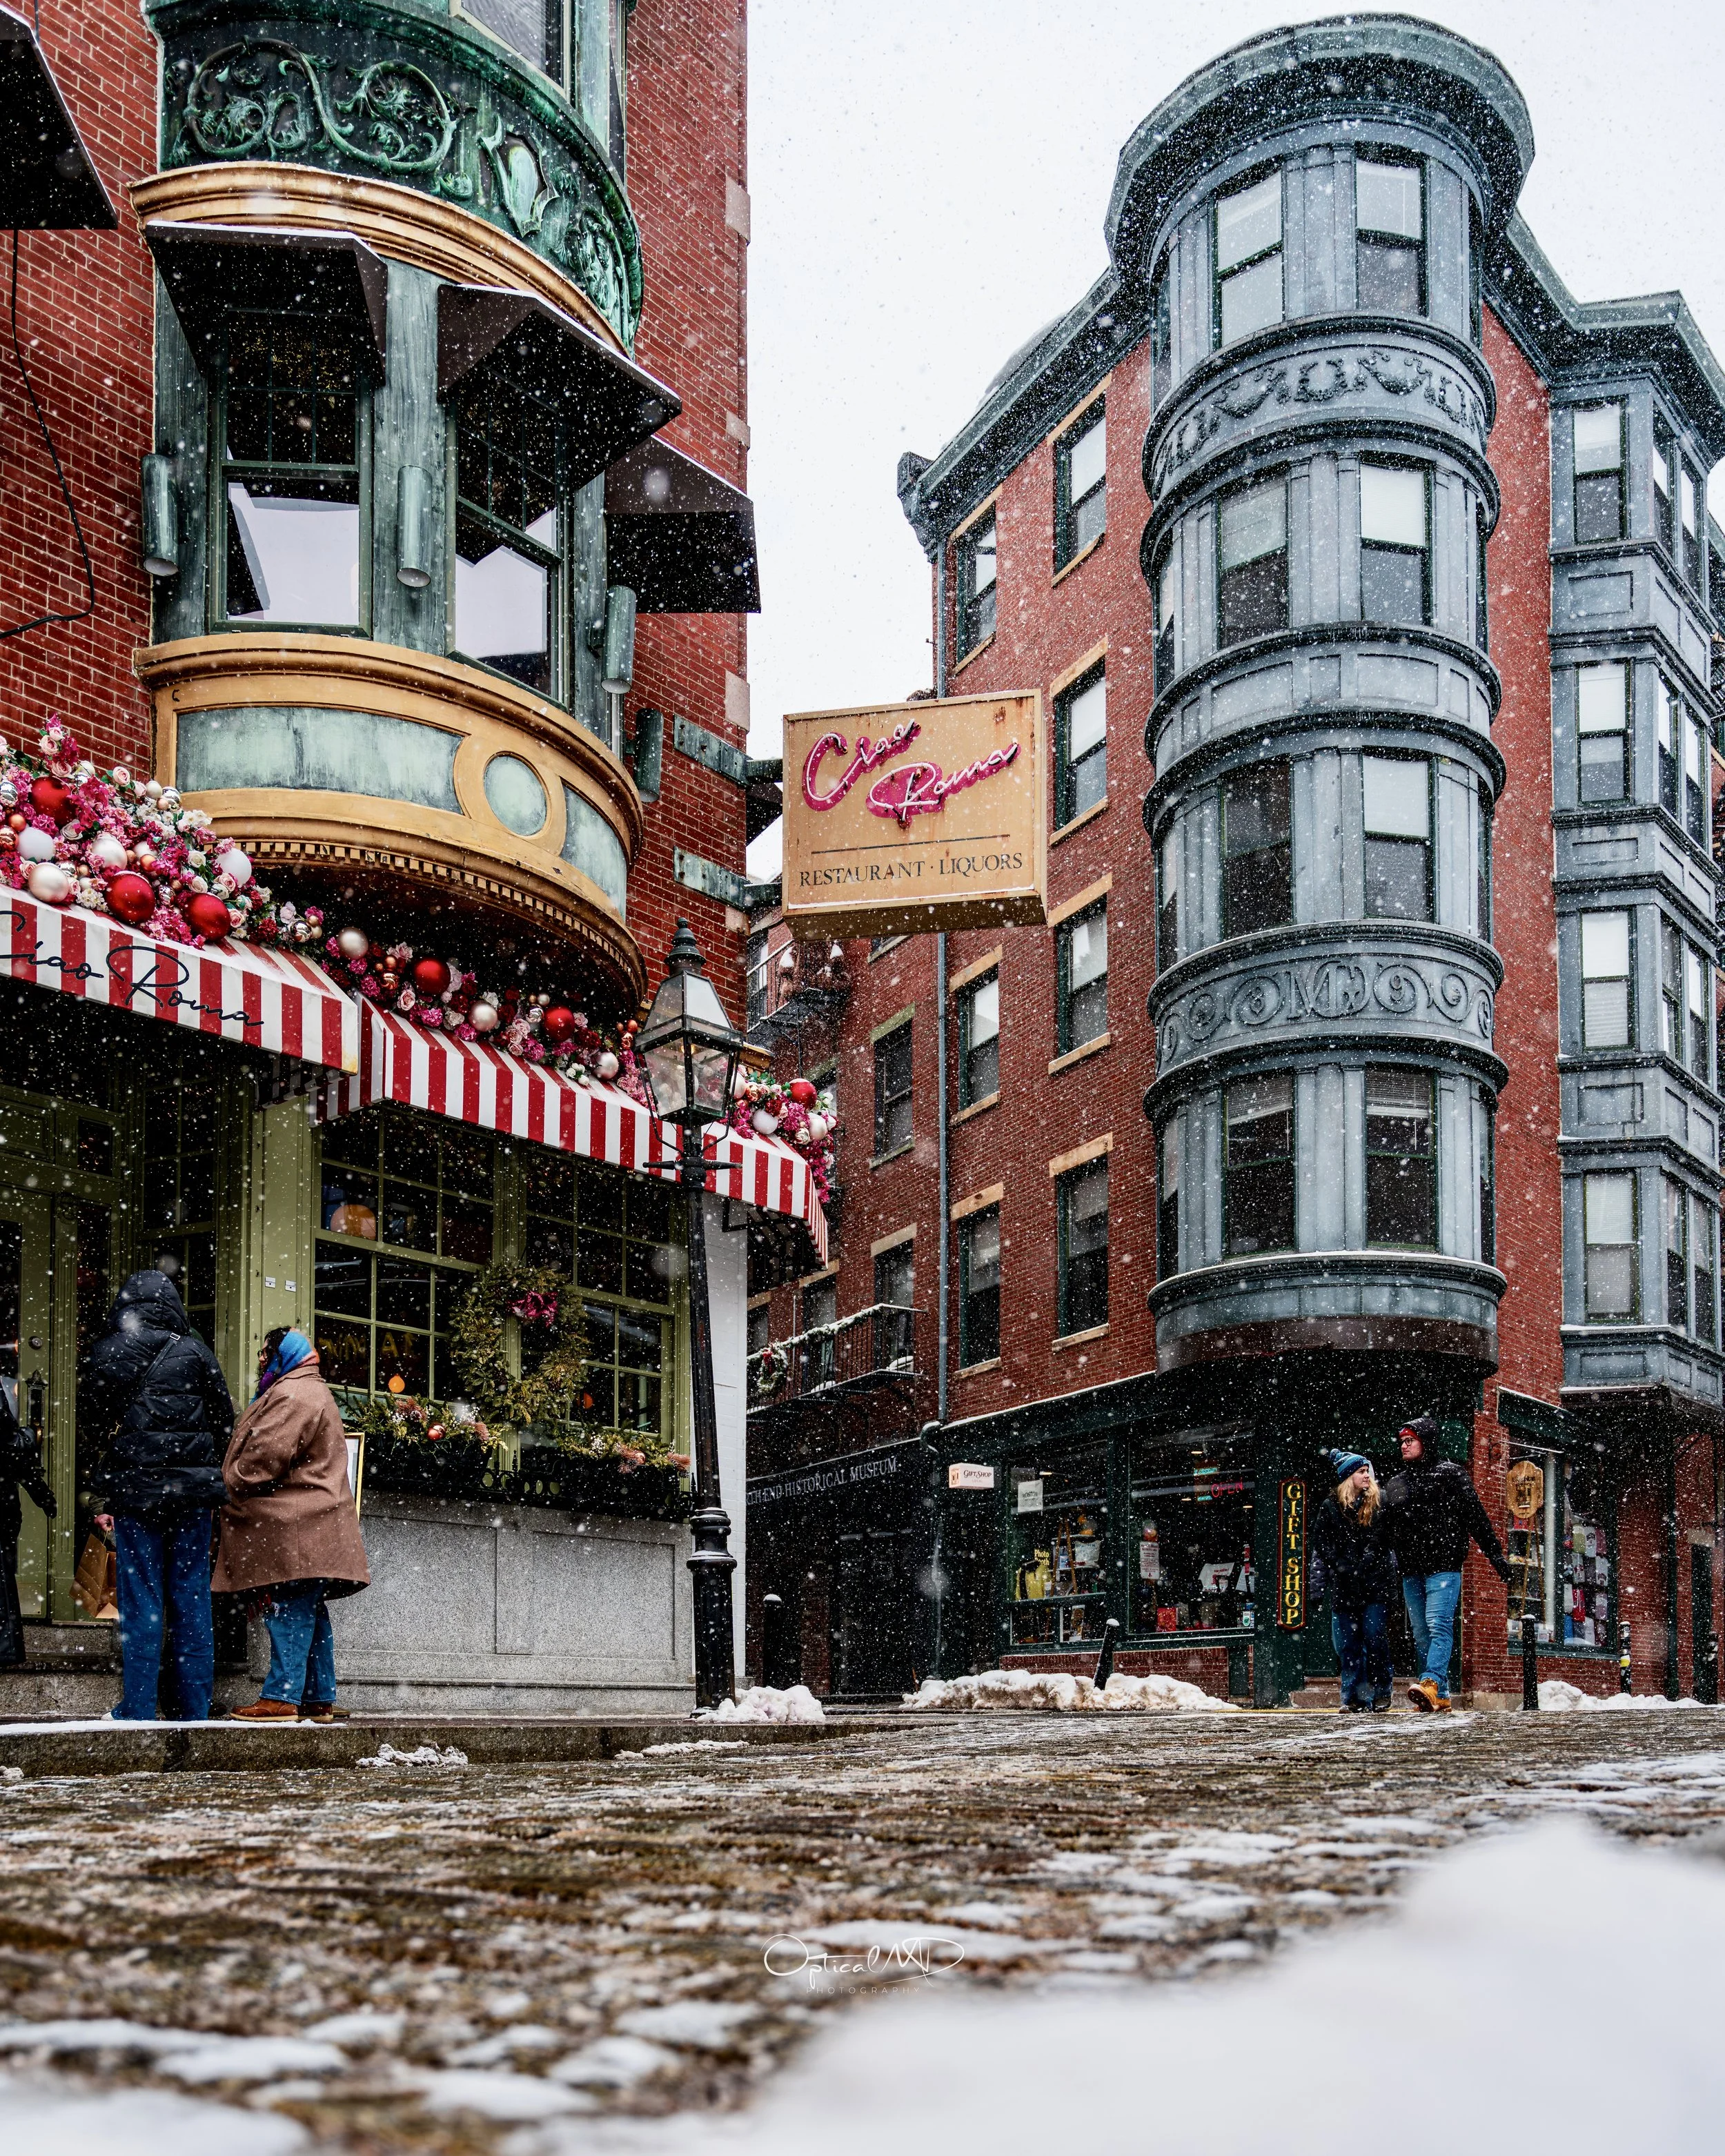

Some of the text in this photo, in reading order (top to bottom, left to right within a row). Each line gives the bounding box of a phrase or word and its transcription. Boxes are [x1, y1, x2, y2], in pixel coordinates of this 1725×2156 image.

[802, 719, 921, 812] Ciao
[800, 853, 1023, 887] RESTAURANT LIQUORS
[106, 945, 265, 1027] Roma
[764, 1485, 782, 1501] END
[785, 1470, 847, 1497] HISTORICAL
[849, 1457, 897, 1482] MUSEUM
[963, 1470, 977, 1478] GIFT
[1034, 1549, 1049, 1558] Photo
[1285, 1484, 1301, 1624] GIFT SHOP
